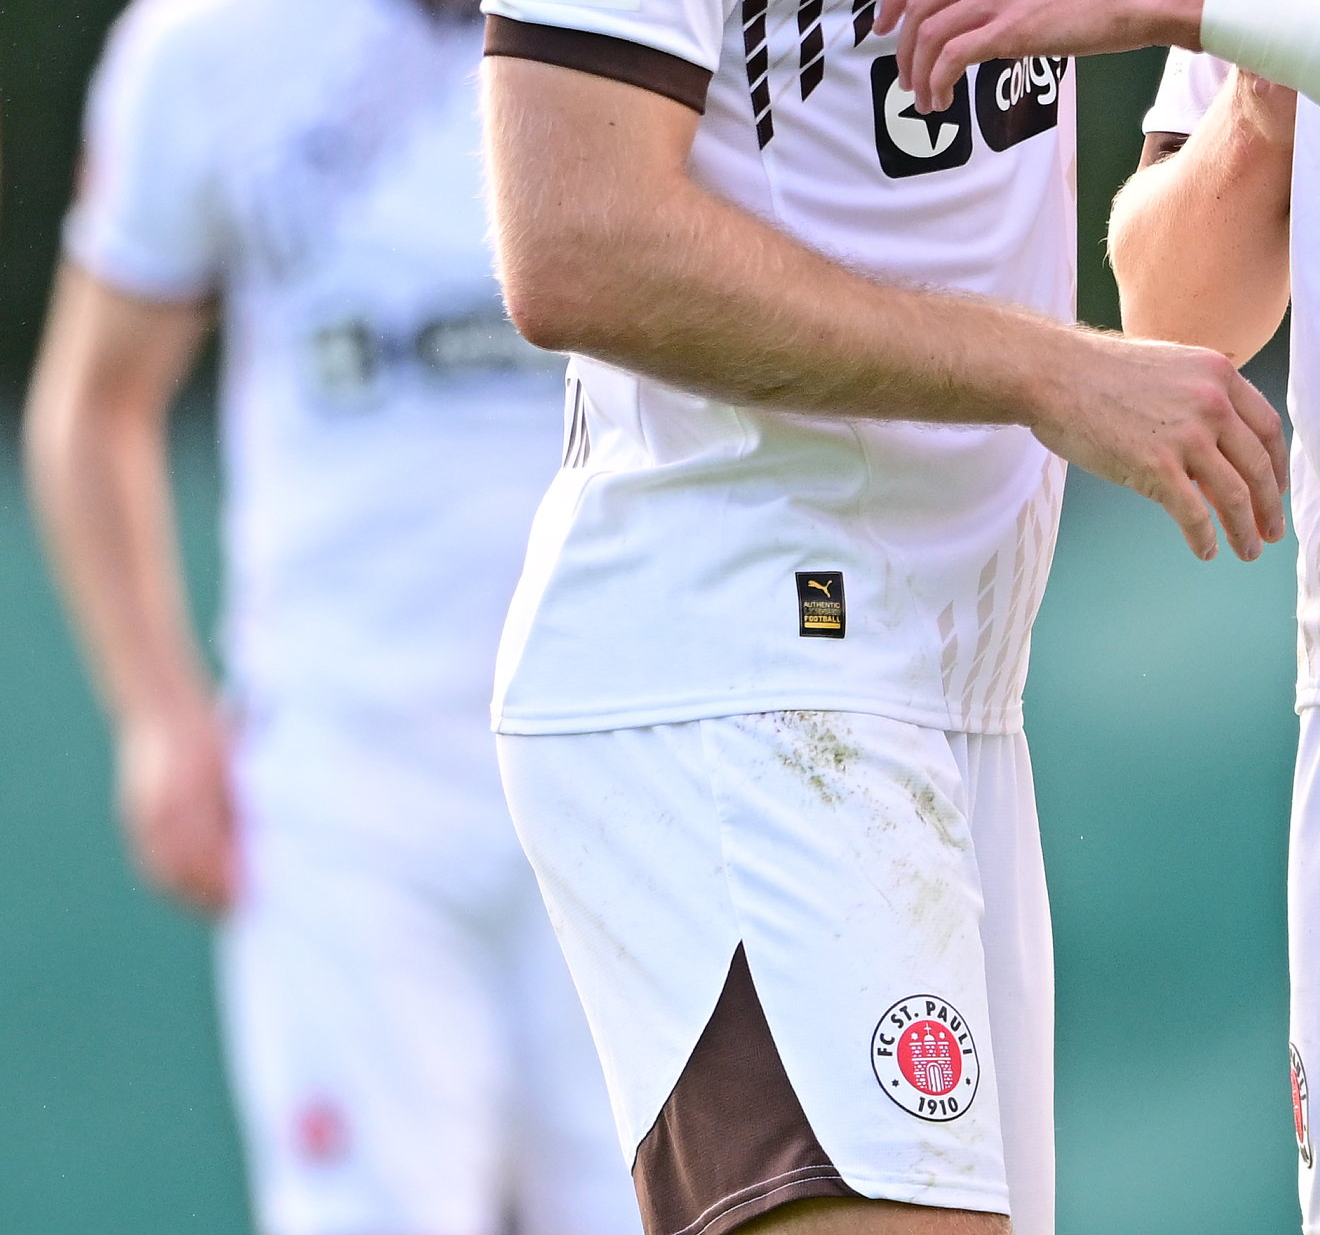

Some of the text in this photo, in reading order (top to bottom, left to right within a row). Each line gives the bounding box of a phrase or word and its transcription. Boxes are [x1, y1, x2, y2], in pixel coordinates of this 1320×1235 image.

[804, 615, 841, 623] FOOTBALL
[877, 1000, 973, 1057] FC ST. PAULI
[918, 1096, 959, 1116] 1910
